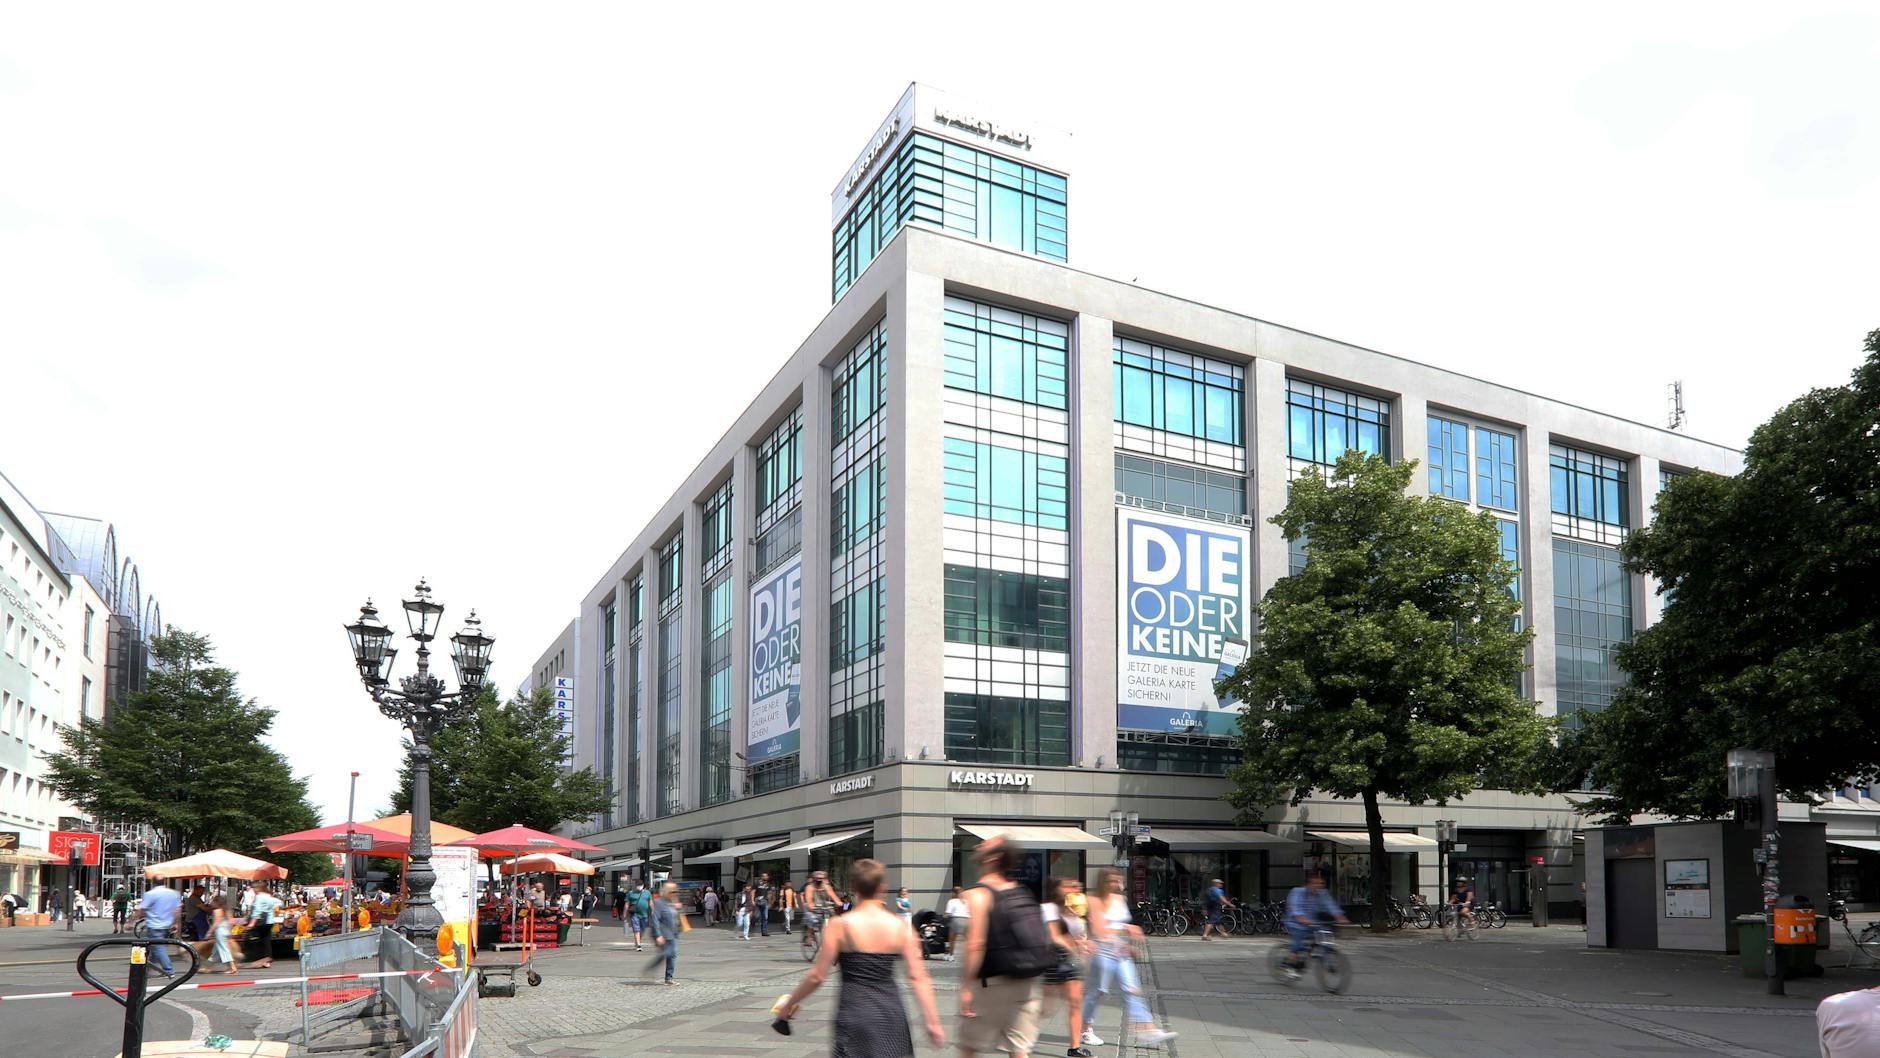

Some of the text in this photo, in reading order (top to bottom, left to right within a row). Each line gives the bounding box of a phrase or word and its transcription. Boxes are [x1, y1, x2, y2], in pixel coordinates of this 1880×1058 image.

[844, 115, 900, 197] KARSTADT
[1132, 523, 1239, 597] DIE
[755, 566, 801, 644] DIE
[1130, 586, 1239, 635] ODER
[754, 623, 801, 674] ODER
[1132, 624, 1223, 660] KEINE
[754, 660, 792, 699] KEINE
[1126, 661, 1196, 677] JETZT DIE NEUE
[1127, 675, 1196, 690] GALERIA KARTE
[1127, 688, 1171, 702] SICHERN!
[1169, 717, 1204, 728] GALERIA
[830, 775, 873, 795] KARSTADT
[951, 770, 1035, 786] KARSTADT
